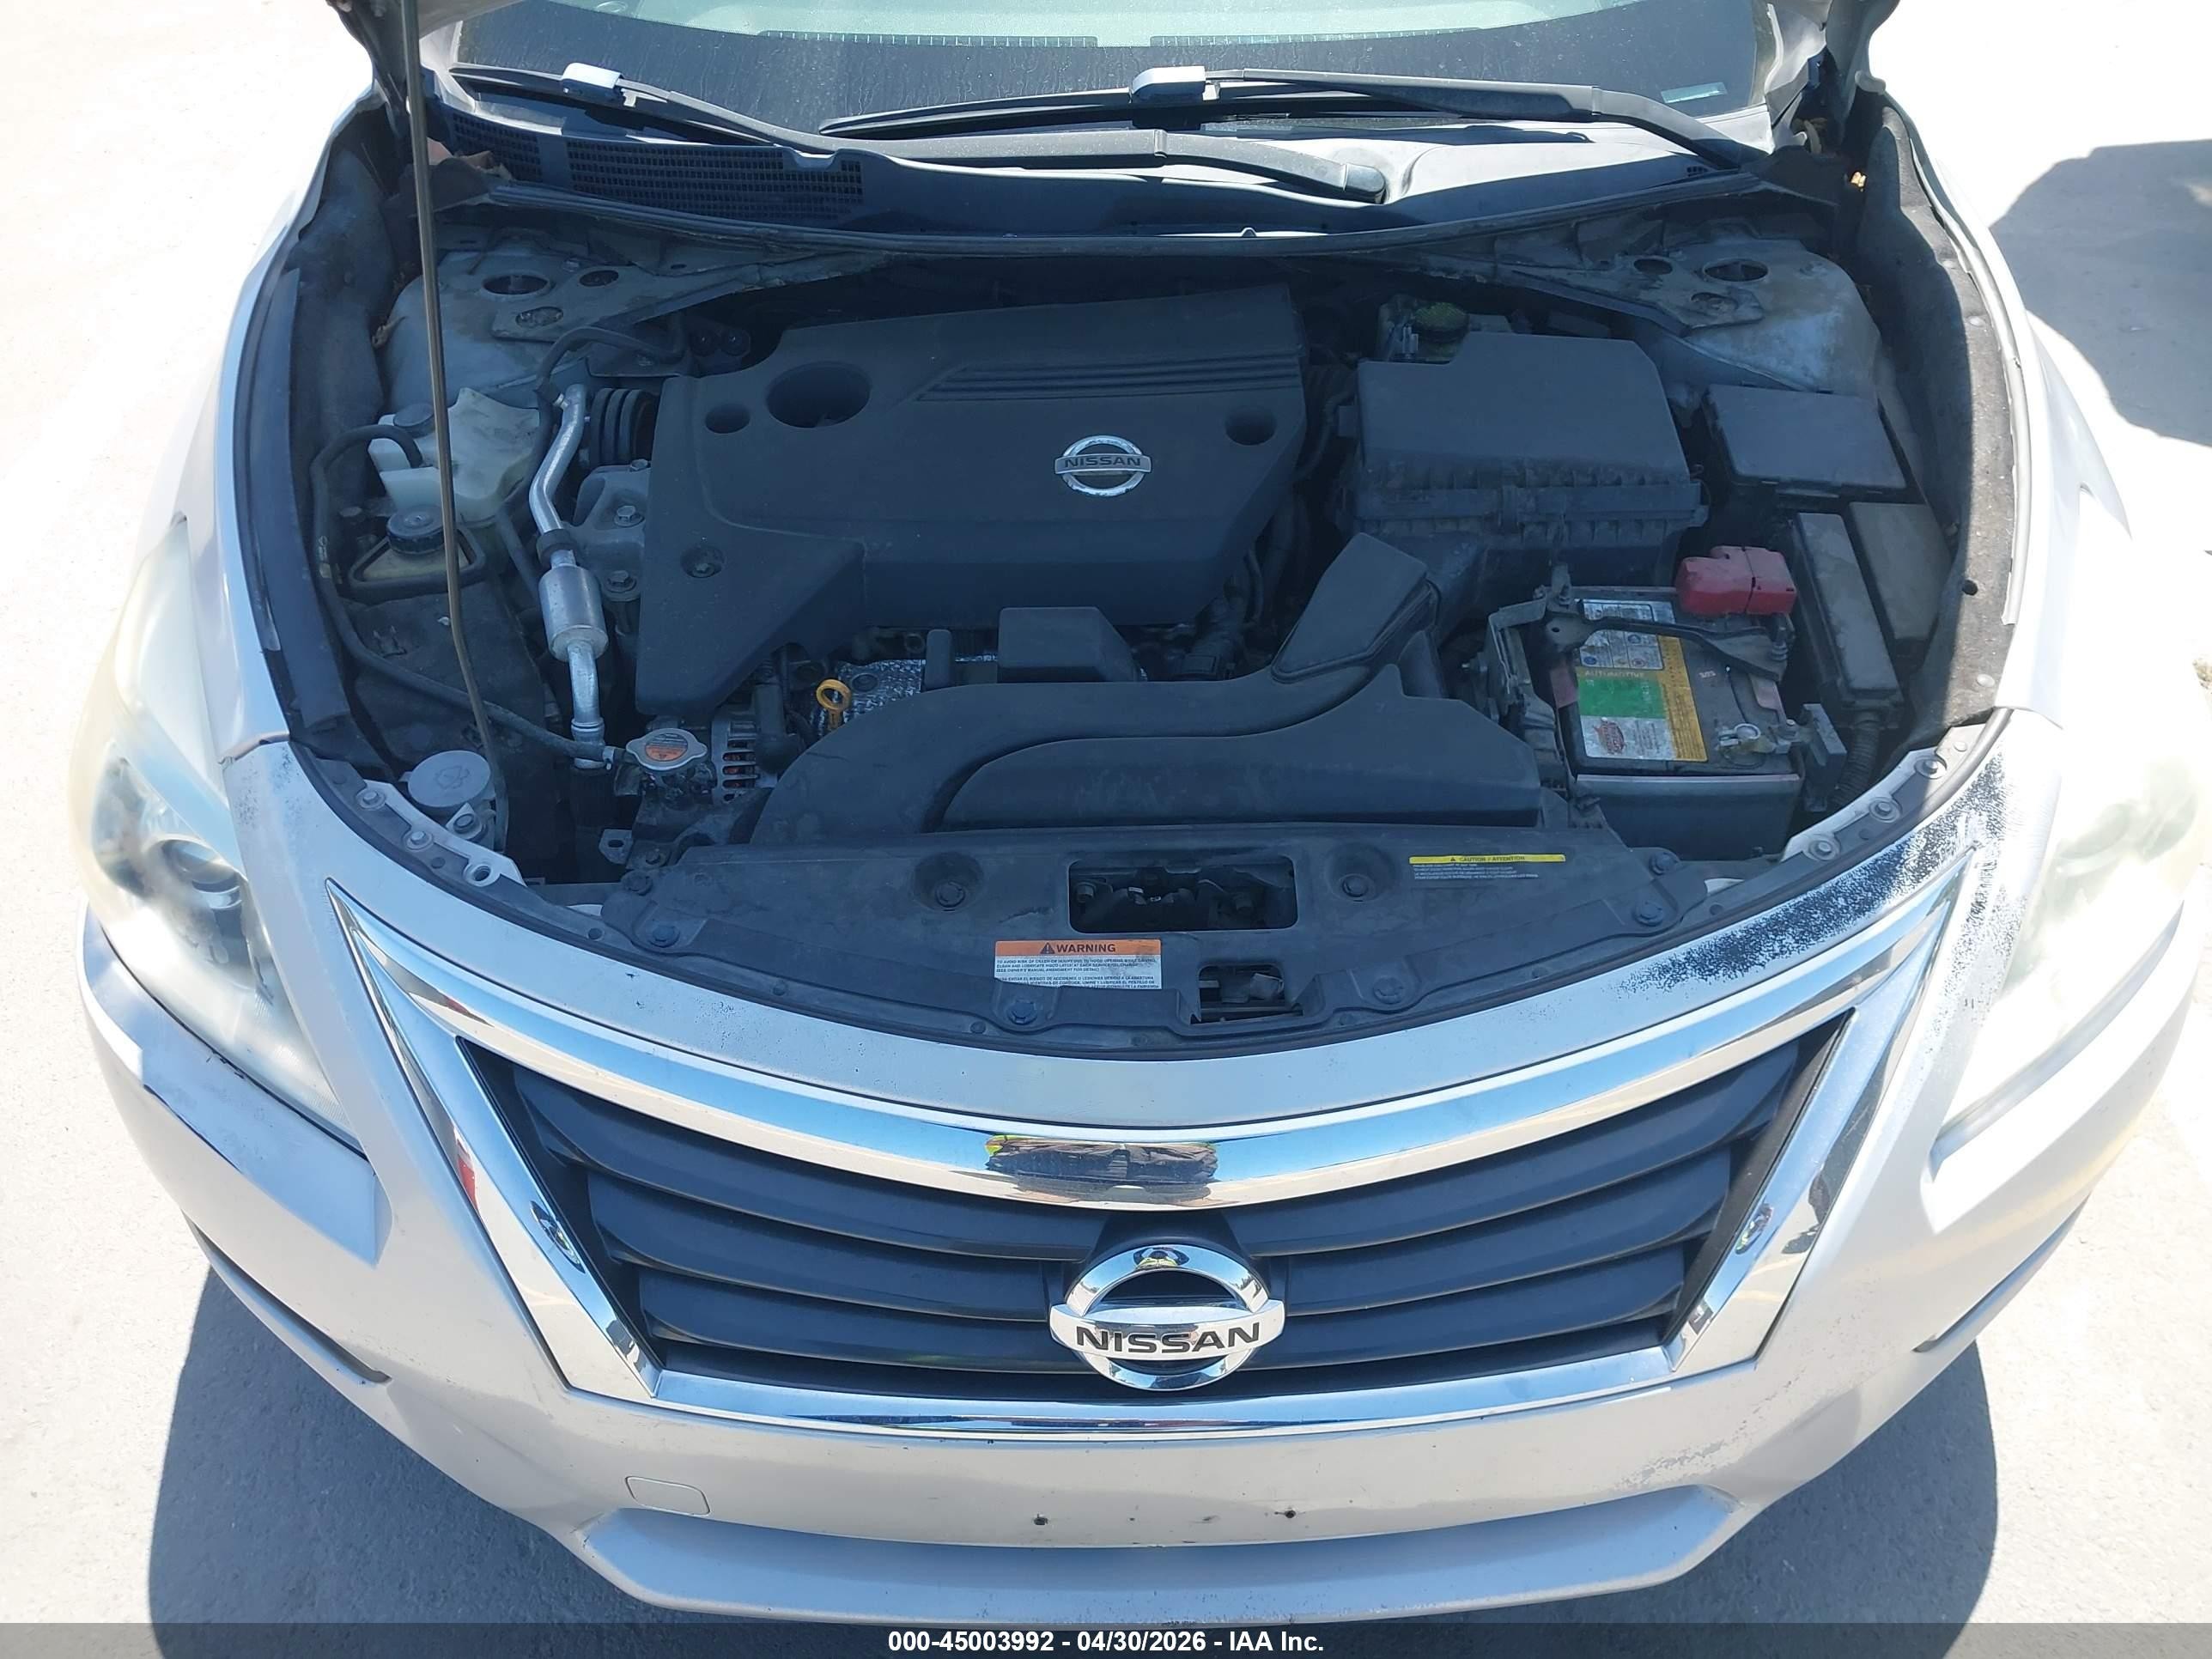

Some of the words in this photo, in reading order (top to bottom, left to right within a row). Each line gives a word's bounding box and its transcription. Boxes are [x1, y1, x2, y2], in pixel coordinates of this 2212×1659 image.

[1065, 456, 1141, 468] NISSAN
[1056, 944, 1116, 953] WARNING
[1076, 1322, 1260, 1353] NISSAN
